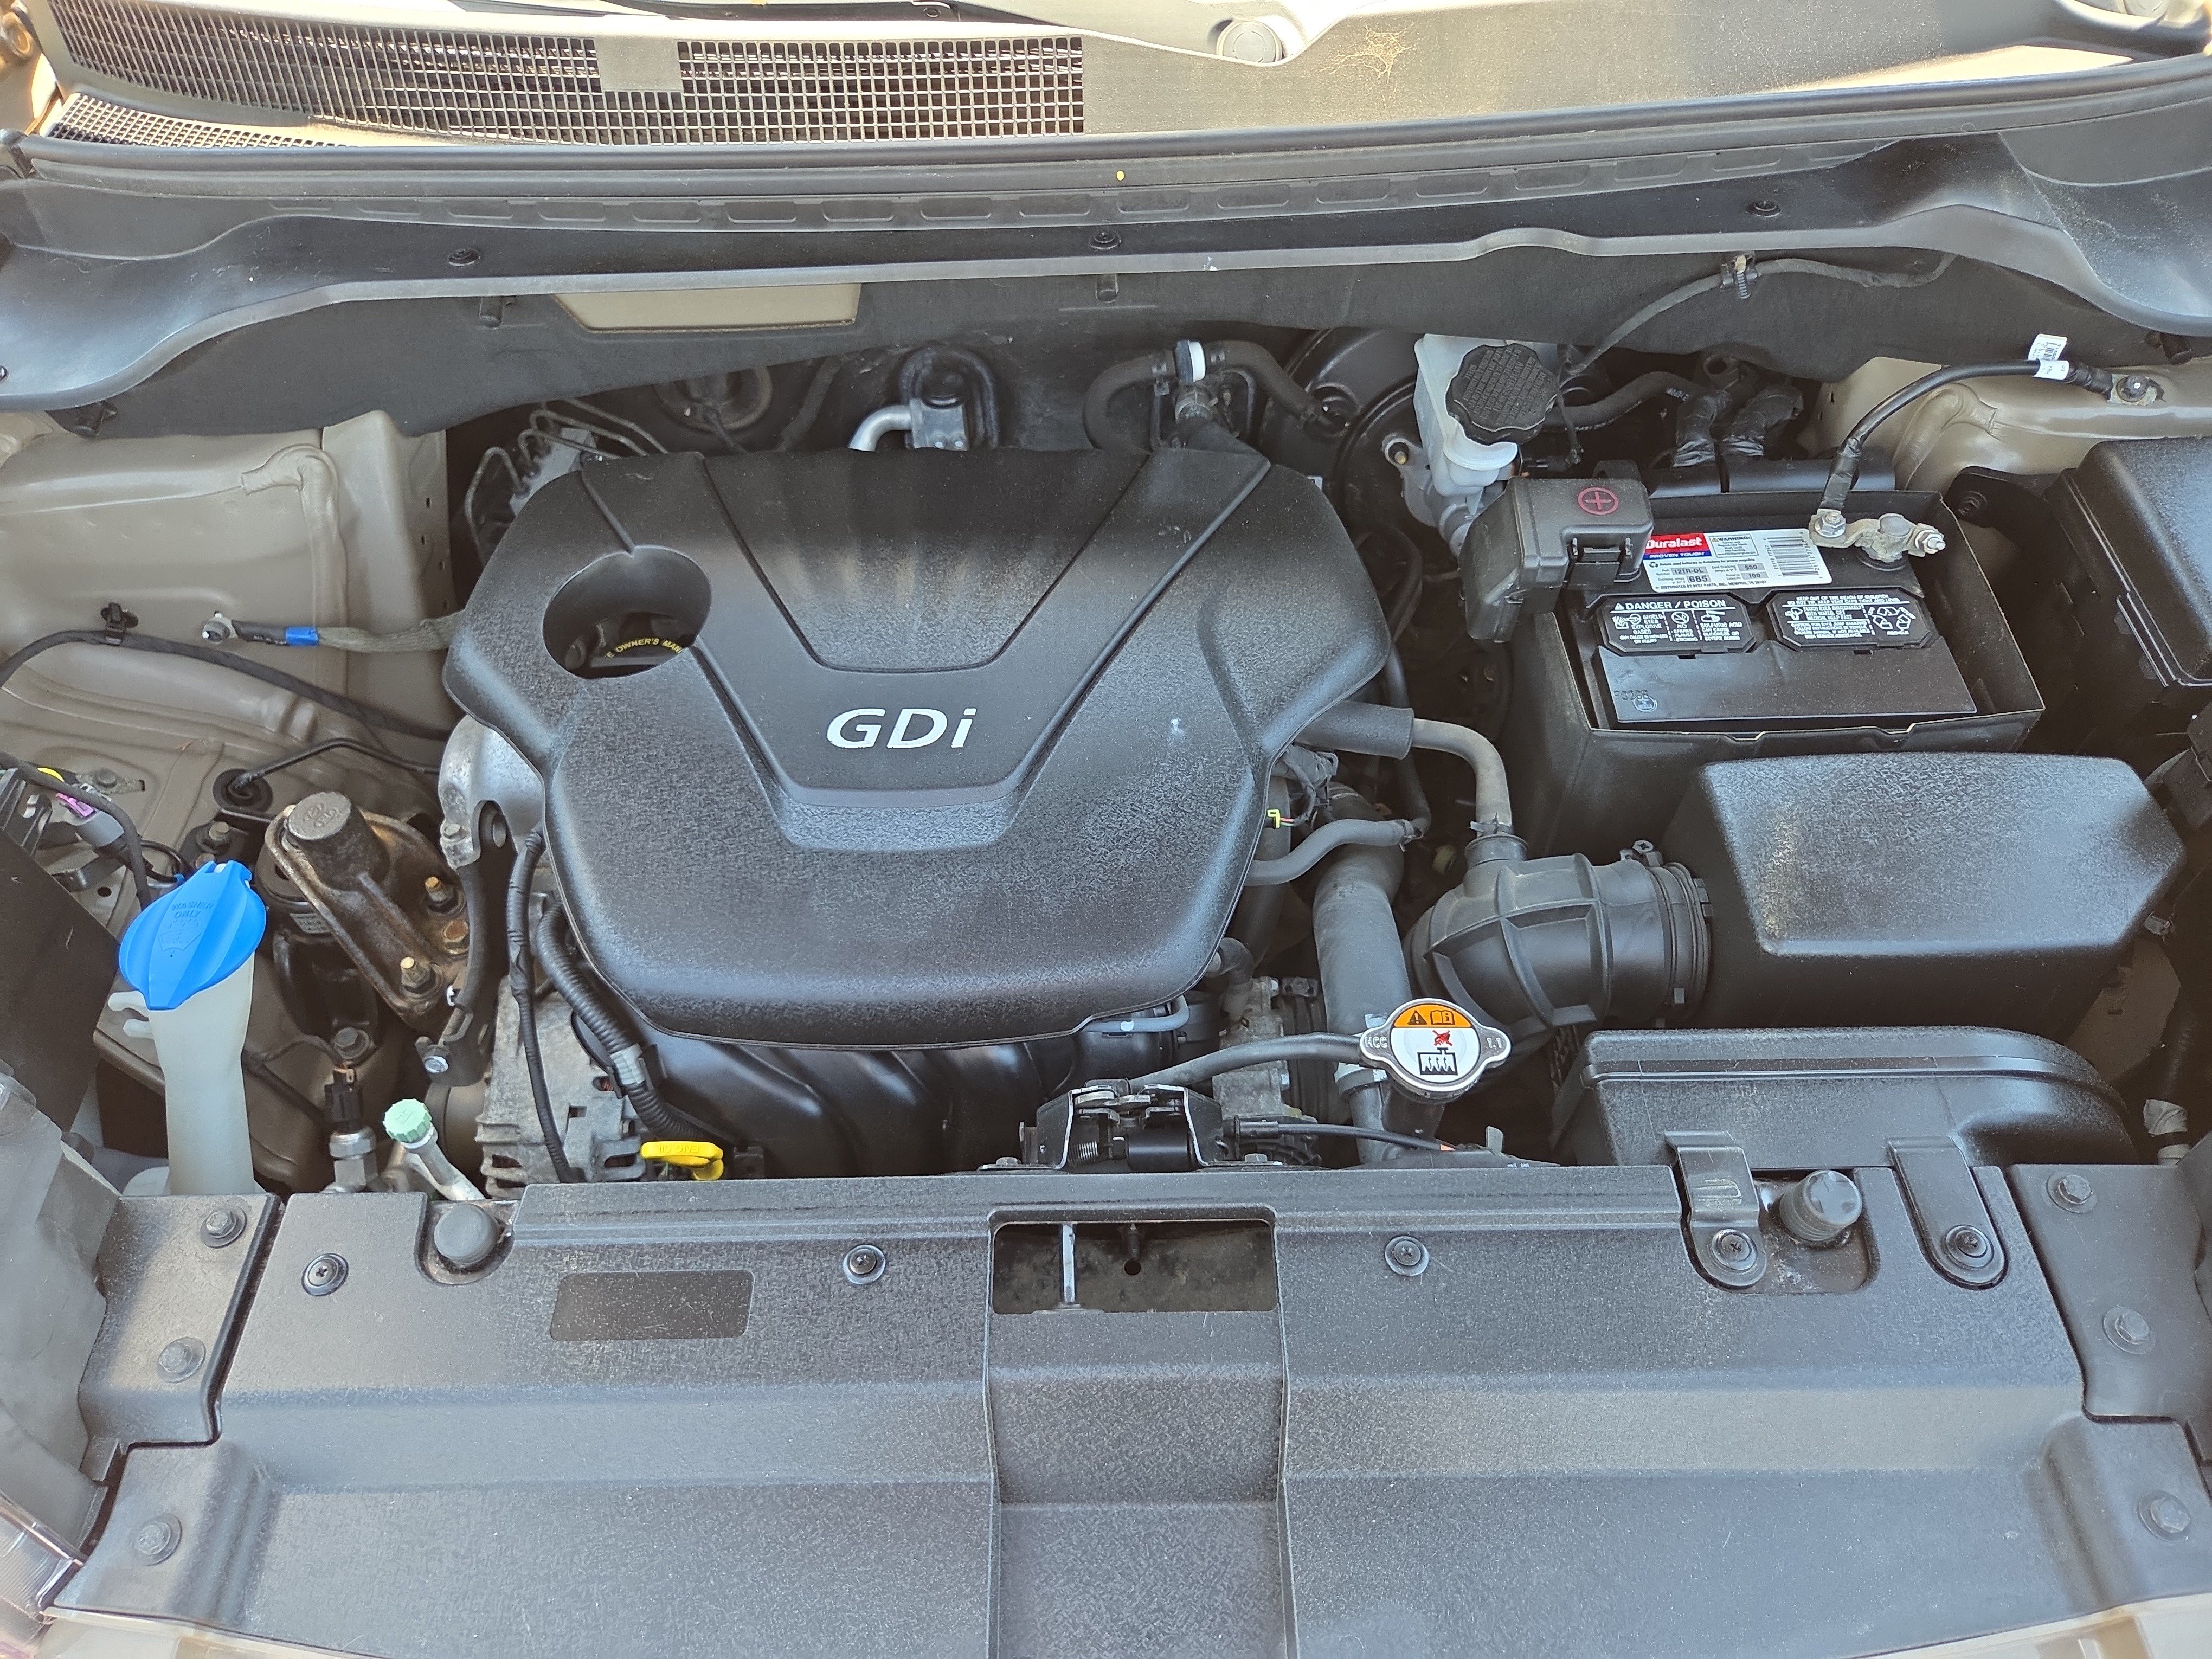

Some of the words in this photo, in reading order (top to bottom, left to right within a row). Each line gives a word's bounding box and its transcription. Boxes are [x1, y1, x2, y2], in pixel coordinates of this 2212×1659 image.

[1645, 537, 1703, 549] Duralast
[1625, 601, 1673, 610] DANGER
[1683, 600, 1727, 608] POISON
[615, 638, 660, 653] OWNER'S
[826, 708, 977, 749] GDi
[172, 901, 215, 911] WASHER
[175, 910, 201, 918] ONLY
[1364, 1036, 1388, 1049] HCC
[1486, 1037, 1503, 1049] 1.1
[659, 1144, 672, 1153] OIL
[677, 1144, 700, 1154] ENG
